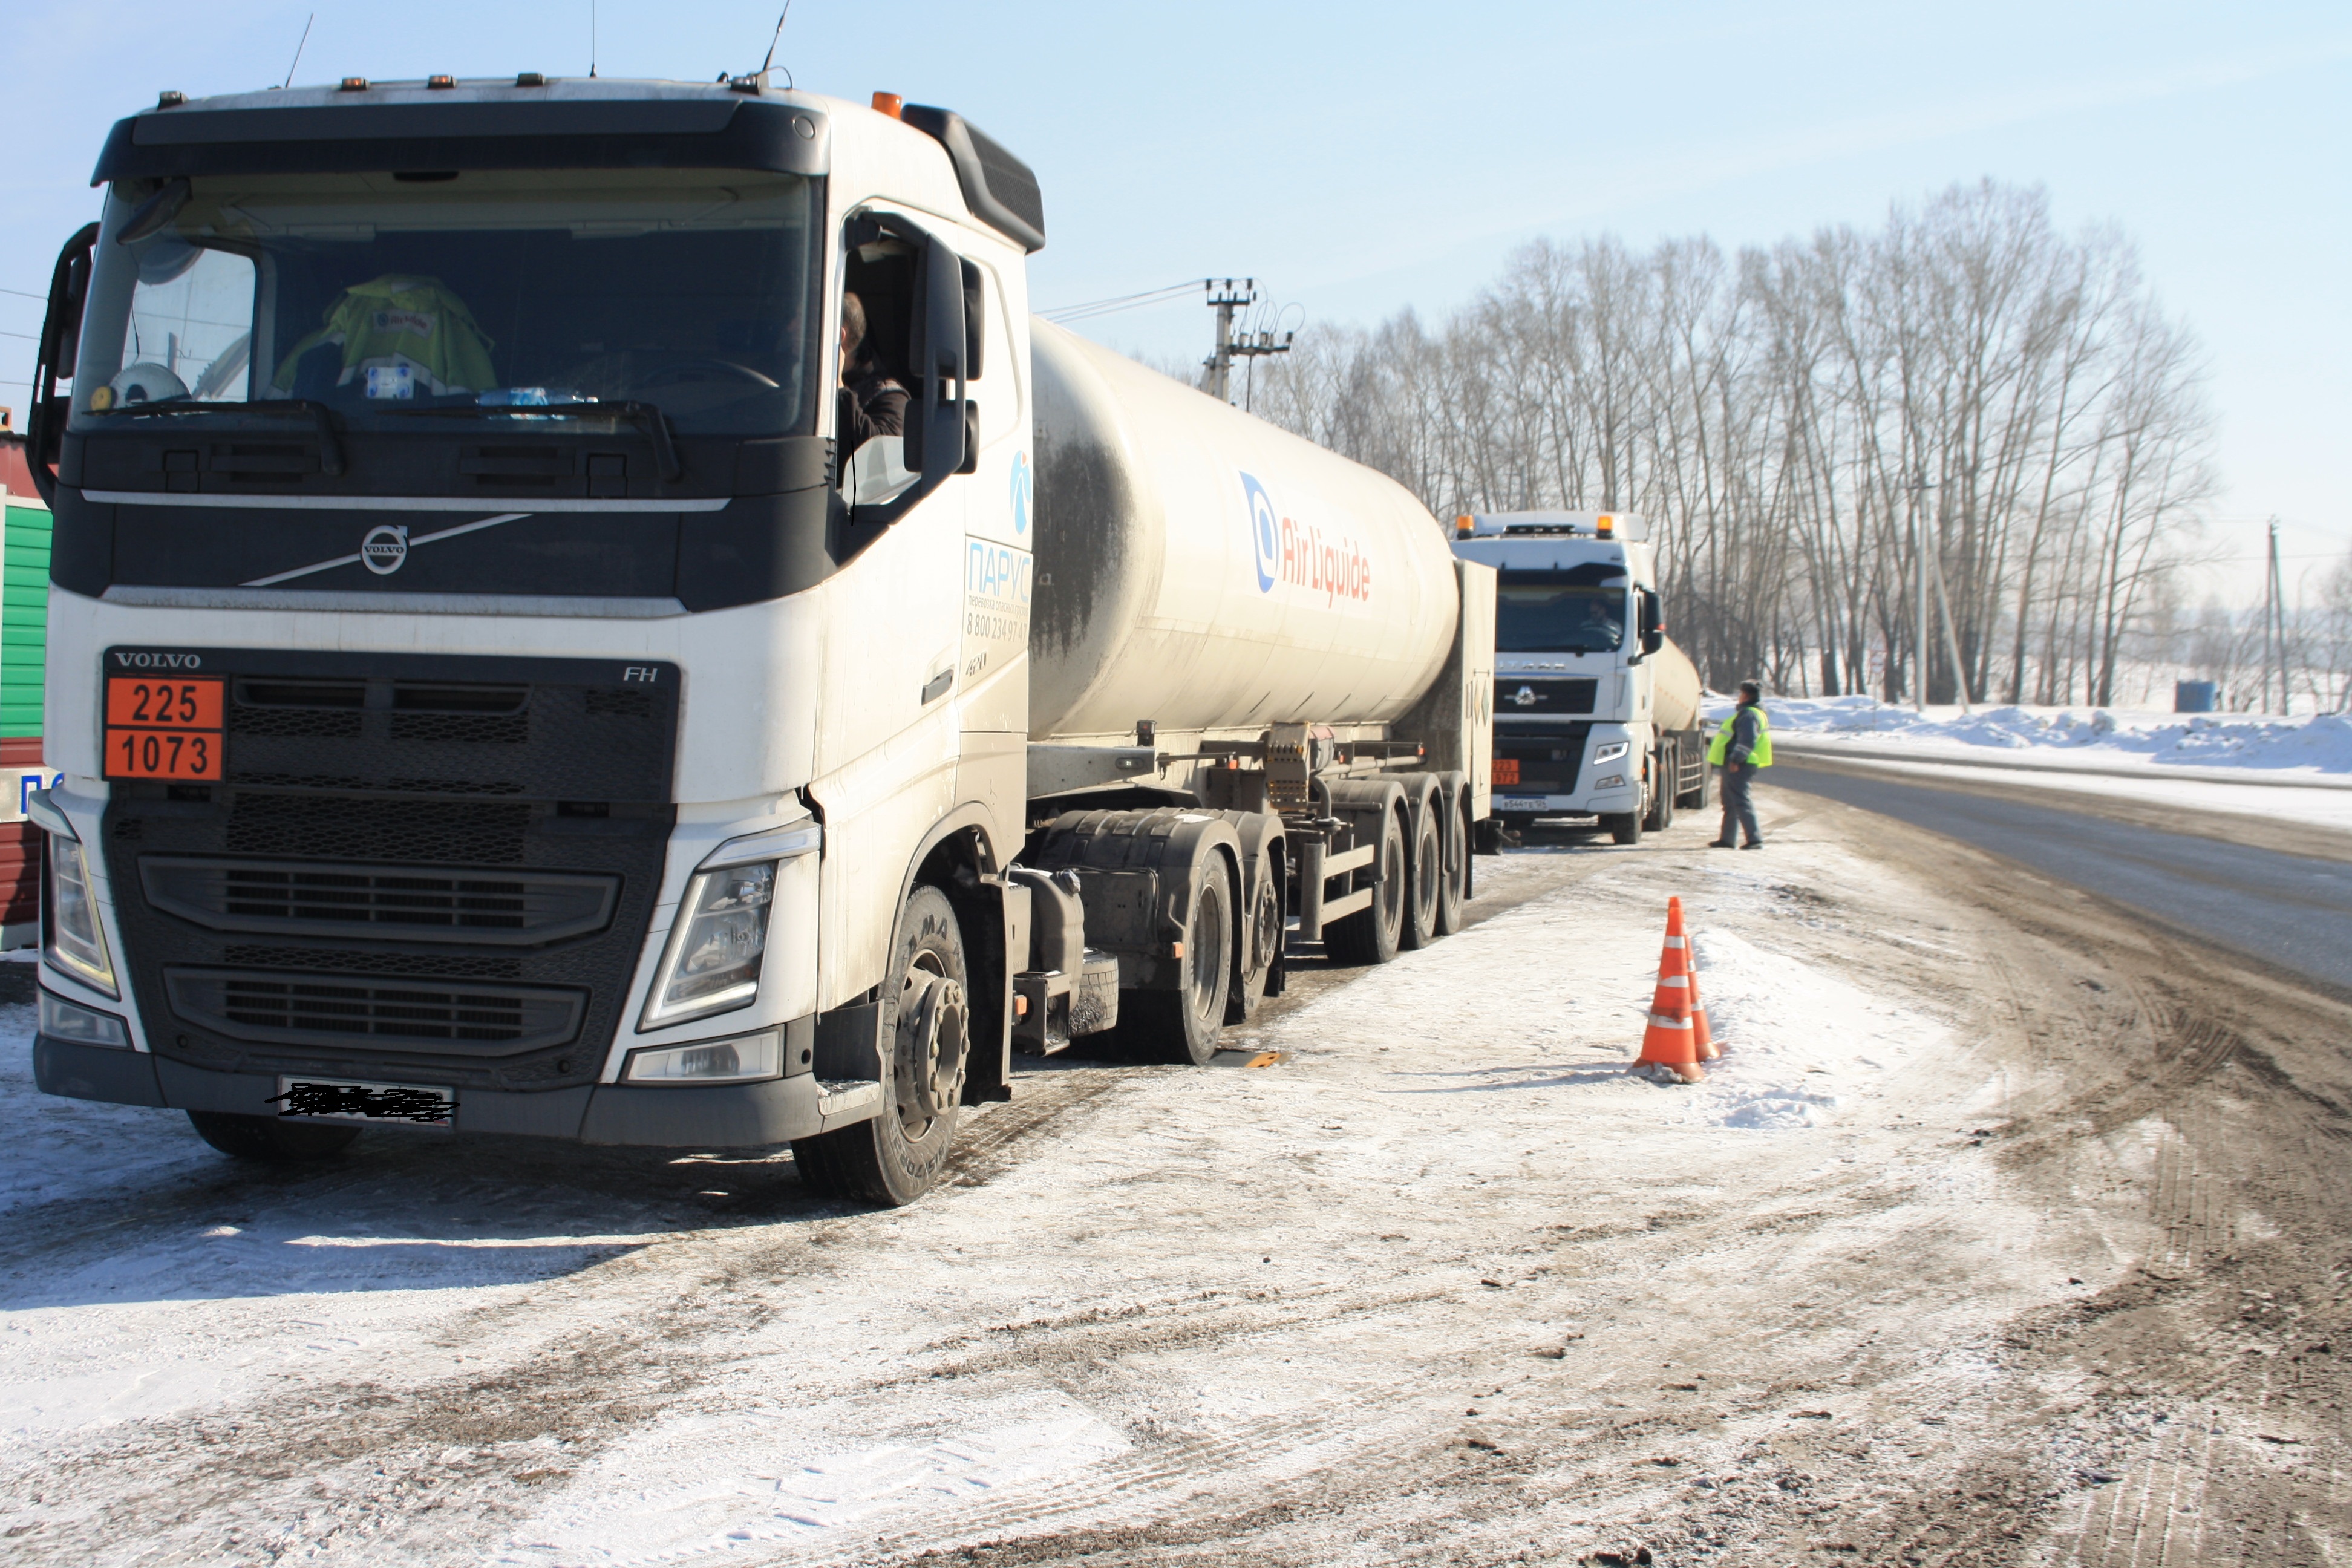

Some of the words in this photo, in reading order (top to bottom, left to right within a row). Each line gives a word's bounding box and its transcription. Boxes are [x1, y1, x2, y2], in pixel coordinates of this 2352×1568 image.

[969, 542, 1030, 603] ПАРУС
[1282, 517, 1308, 586] Air
[1309, 525, 1370, 609] Liquide
[967, 612, 973, 635] 8
[975, 613, 991, 638] 800
[992, 616, 1007, 641] 234
[1008, 620, 1018, 642] 97
[1018, 622, 1027, 644] 47
[115, 653, 201, 668] VOLVO
[624, 667, 658, 682] FH
[1495, 660, 1566, 670] ITRAK
[132, 684, 197, 722] 225
[123, 734, 207, 774] 1073
[1492, 773, 1515, 783] 972
